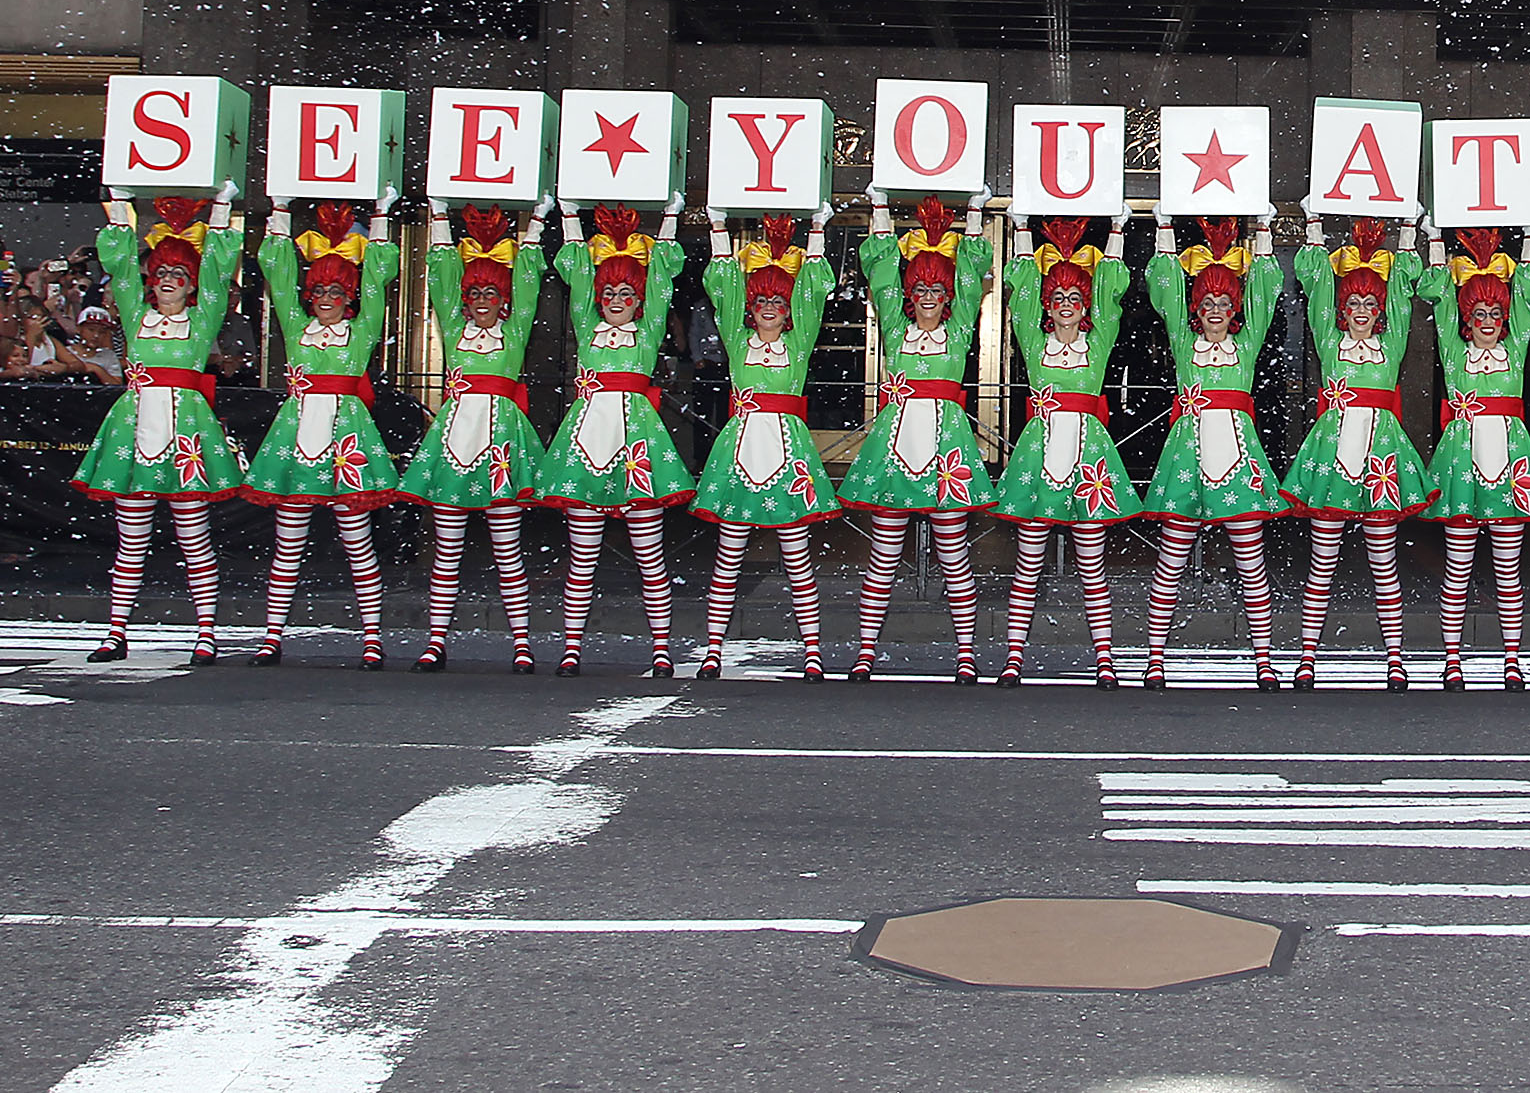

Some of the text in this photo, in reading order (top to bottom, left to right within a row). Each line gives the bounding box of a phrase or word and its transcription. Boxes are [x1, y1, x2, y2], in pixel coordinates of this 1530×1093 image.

[128, 90, 519, 184] SEE
[728, 95, 1105, 200] YOU
[1323, 122, 1521, 212] AT
[16, 177, 55, 187] Center
[58, 443, 90, 451] JANUA
